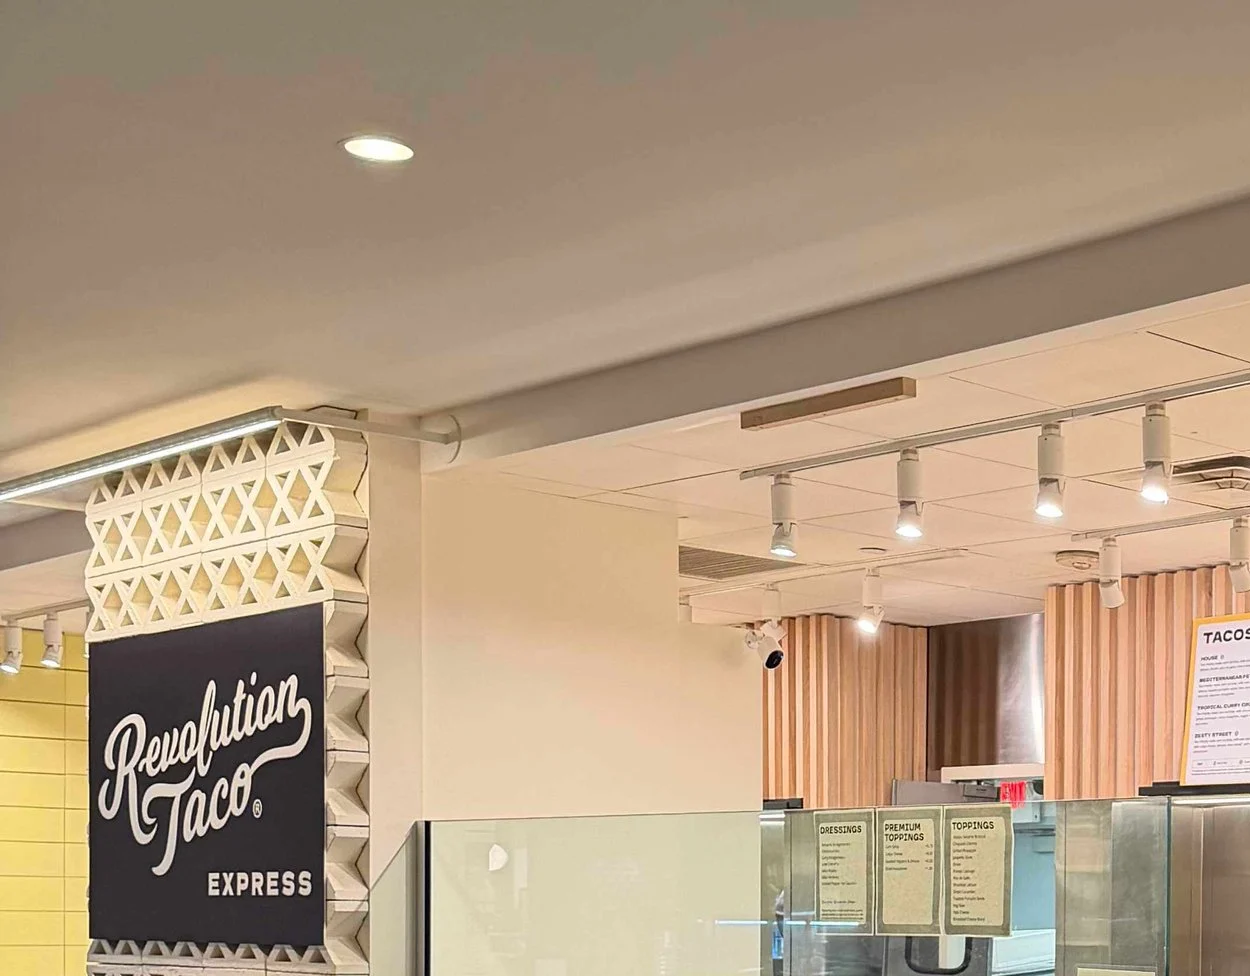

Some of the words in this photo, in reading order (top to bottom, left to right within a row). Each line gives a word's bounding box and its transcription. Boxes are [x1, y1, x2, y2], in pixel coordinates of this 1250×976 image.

[98, 672, 312, 848] Revolution
[820, 825, 862, 834] DRESSINGS
[885, 823, 921, 832] PREMIUM
[952, 821, 994, 830] TOPPINGS
[884, 833, 924, 842] TOPPINGS
[208, 871, 312, 896] EXPRESS
